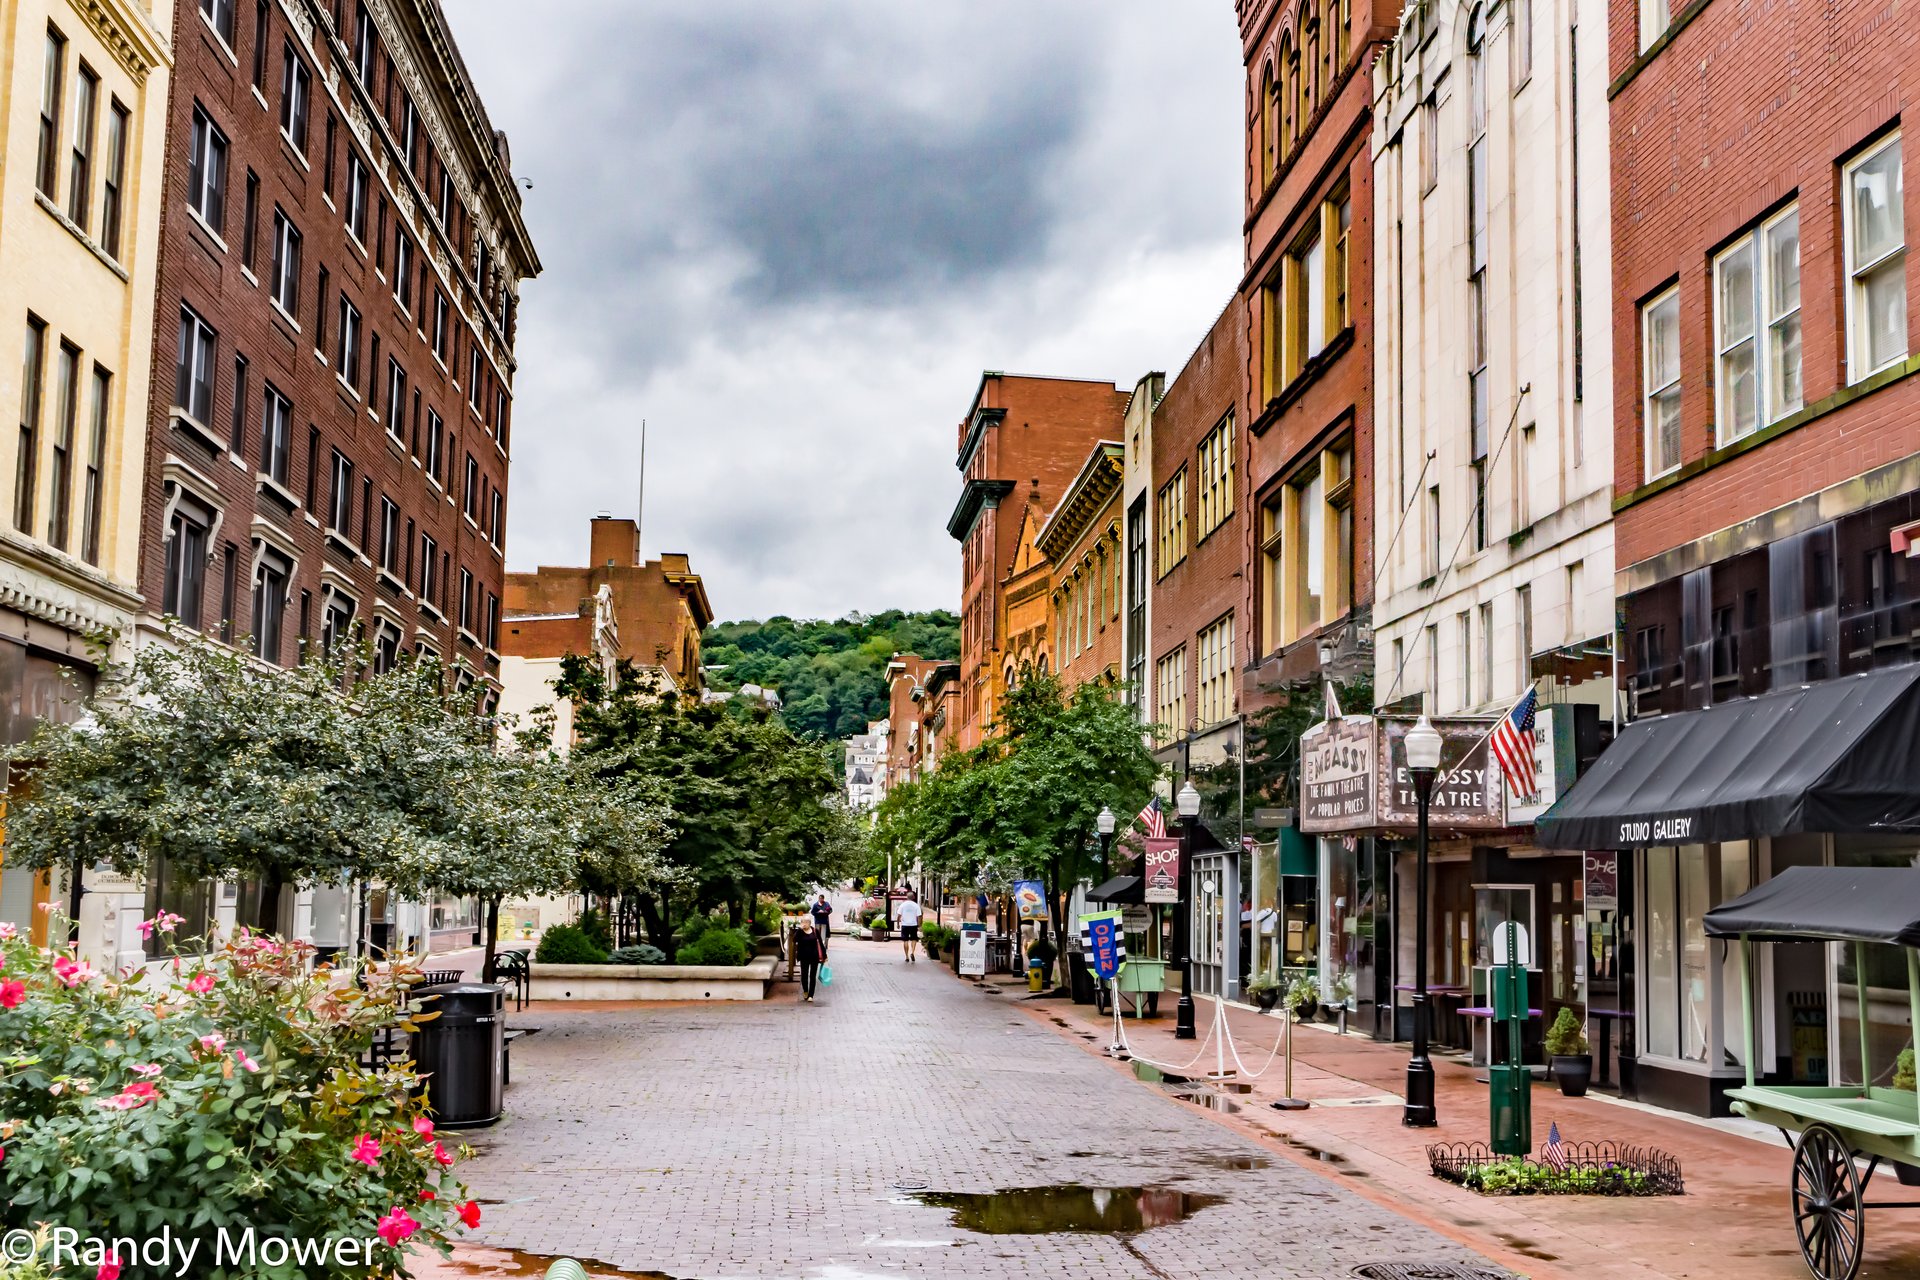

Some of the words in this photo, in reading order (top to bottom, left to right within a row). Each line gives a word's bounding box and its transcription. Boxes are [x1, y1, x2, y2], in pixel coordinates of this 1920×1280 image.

[1396, 767, 1485, 785] EASSY
[1310, 785, 1319, 799] THE
[1320, 782, 1340, 797] FAMILY
[1340, 776, 1364, 794] THEATRE
[1317, 802, 1341, 817] POPULAR
[1344, 797, 1364, 815] PRICES
[1620, 822, 1650, 842] STUDIO
[1653, 817, 1692, 840] GALLERY
[1145, 848, 1179, 866] SHOP
[1095, 924, 1114, 972] OPEN
